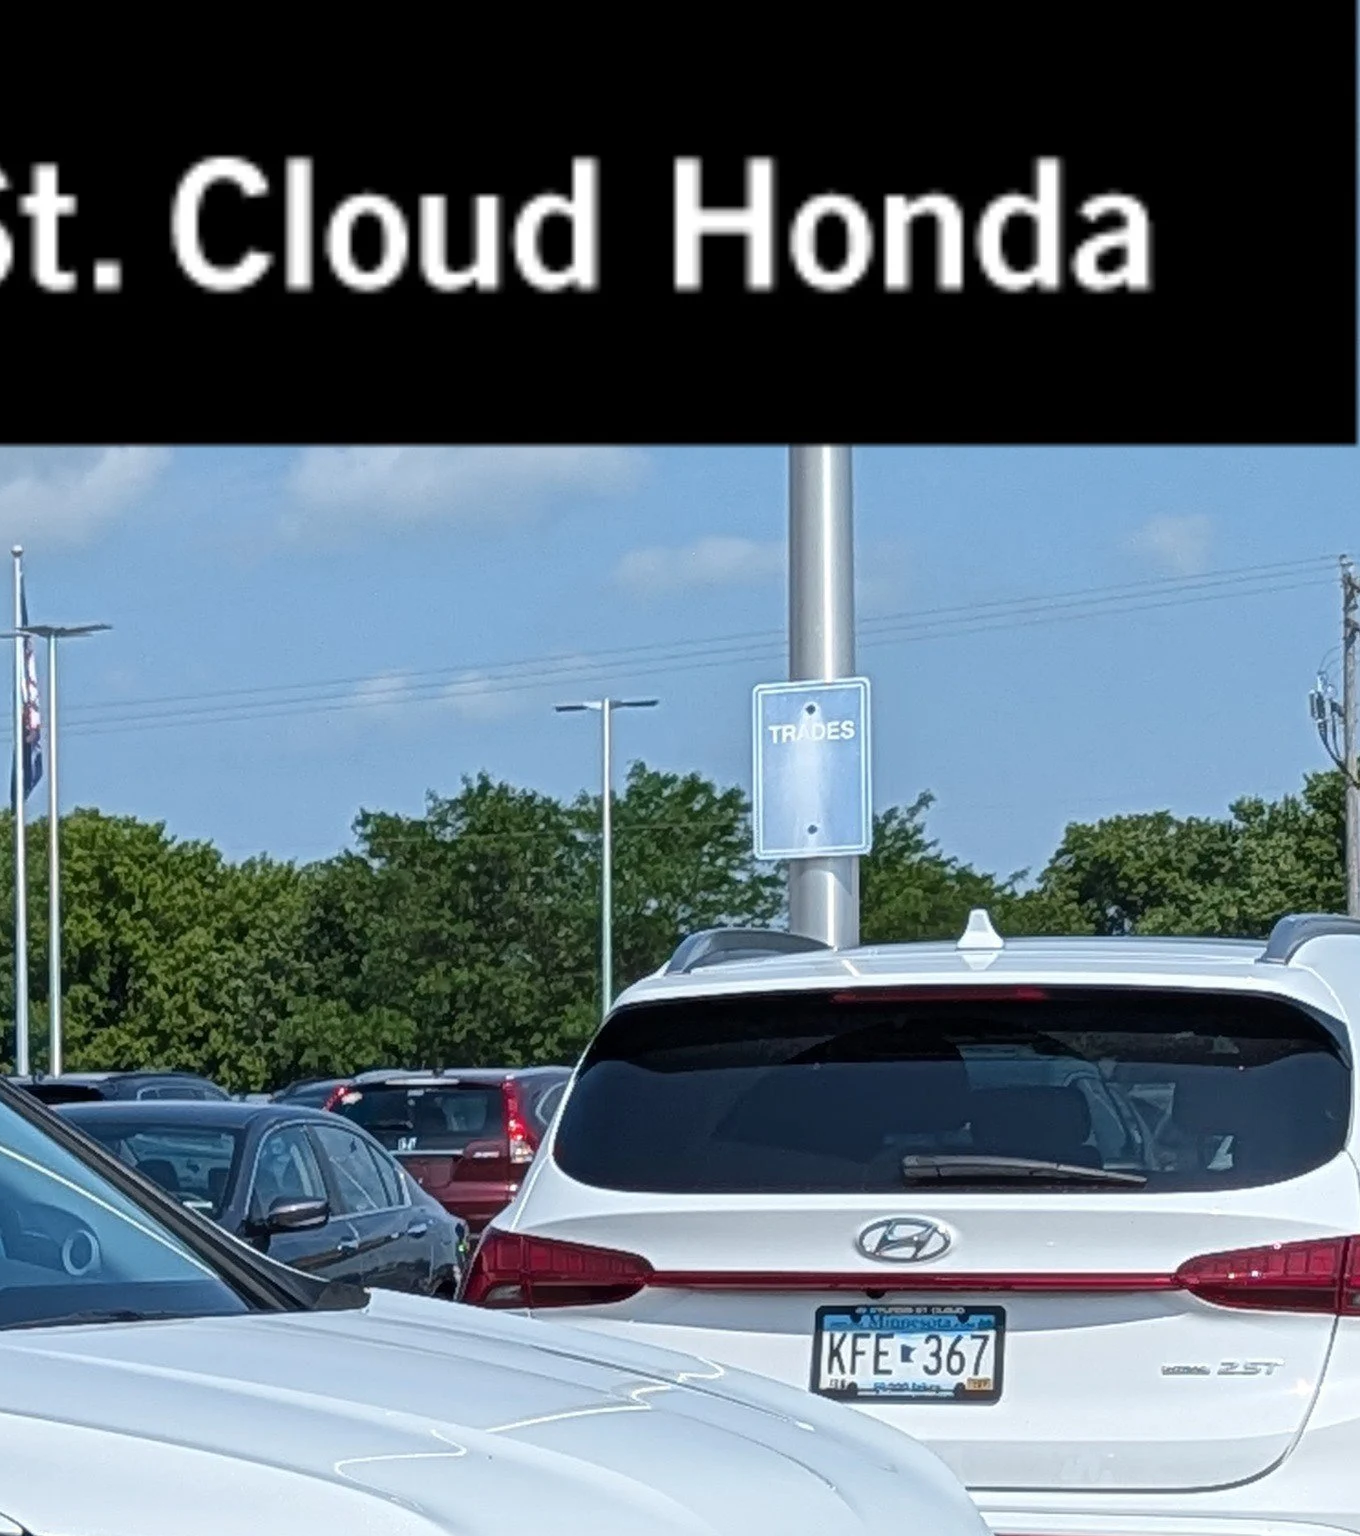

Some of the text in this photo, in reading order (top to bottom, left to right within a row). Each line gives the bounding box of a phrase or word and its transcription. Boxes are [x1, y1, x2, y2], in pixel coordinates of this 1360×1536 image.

[768, 720, 856, 744] TRADES
[868, 1314, 952, 1329] Minnesota
[828, 1332, 990, 1377] KFE 367
